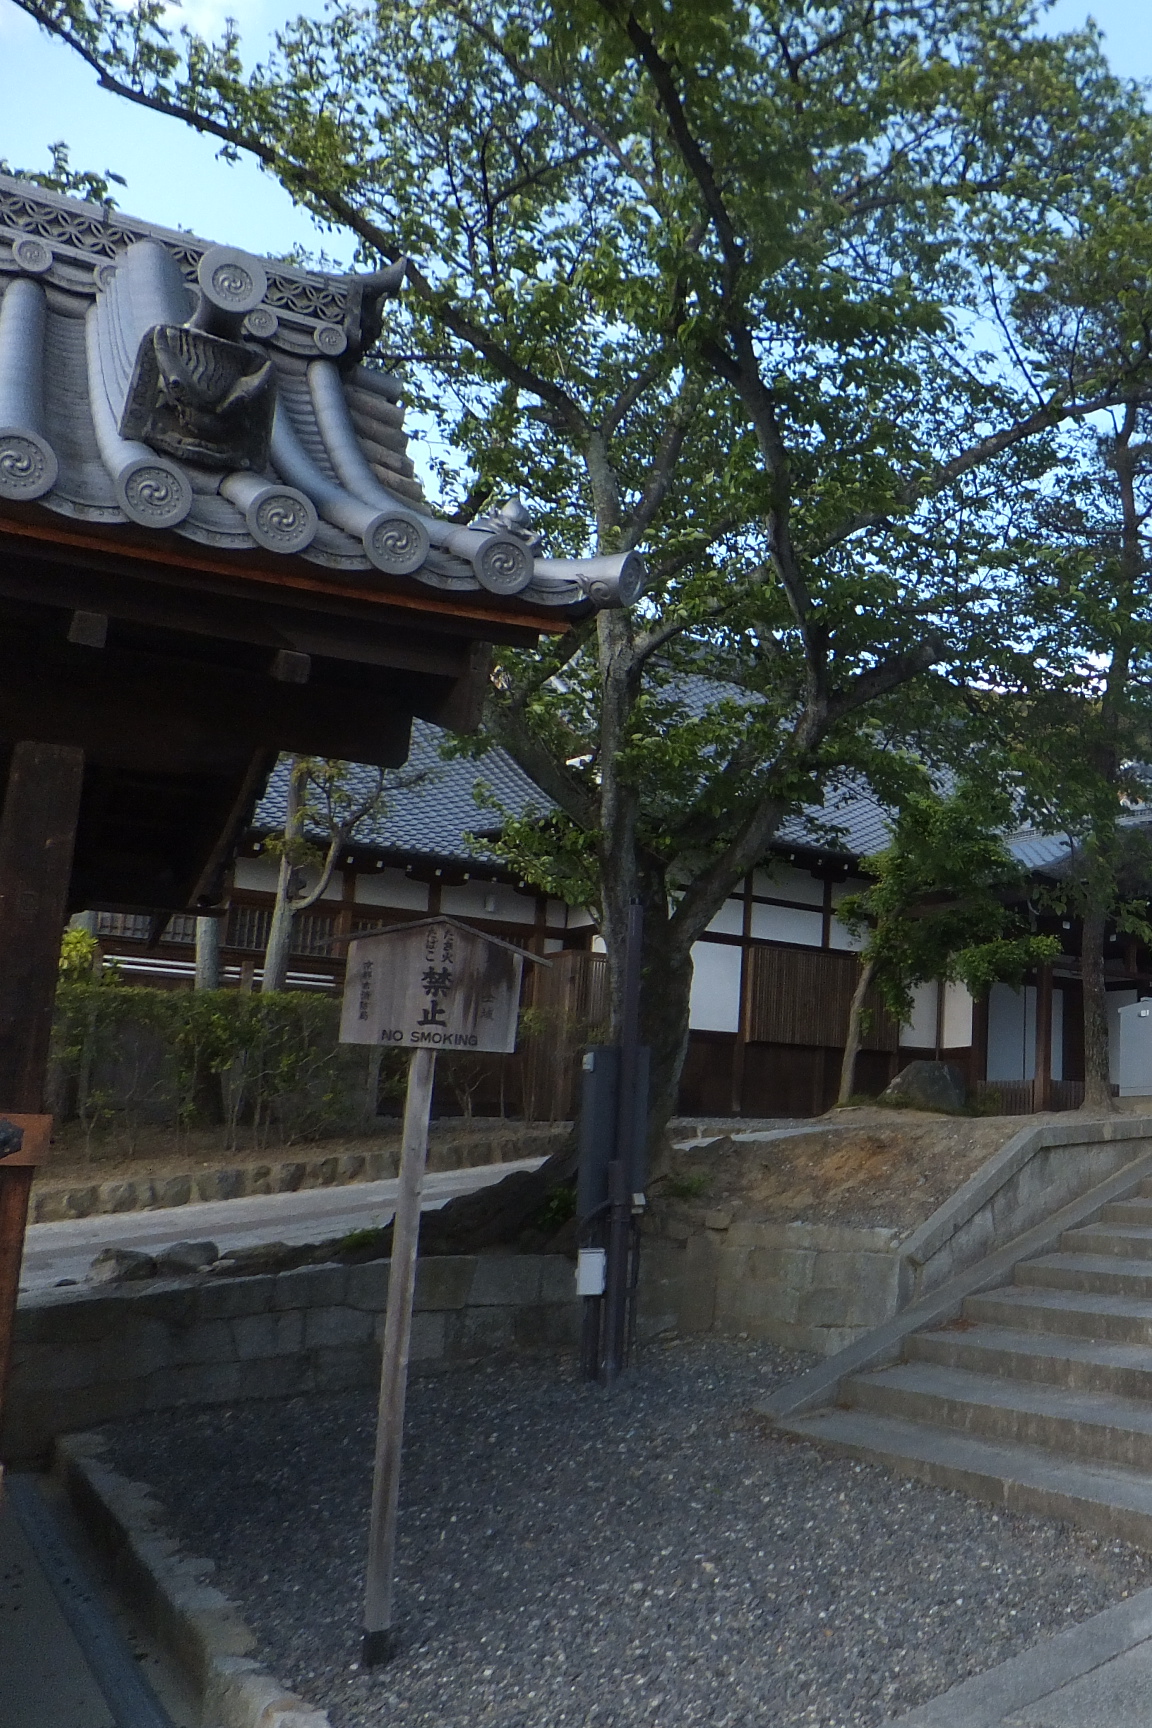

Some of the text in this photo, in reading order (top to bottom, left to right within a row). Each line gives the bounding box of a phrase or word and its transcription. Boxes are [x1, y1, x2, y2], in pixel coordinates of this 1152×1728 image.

[417, 966, 453, 1028] 禁止
[381, 1029, 478, 1047] NO SMOKING
